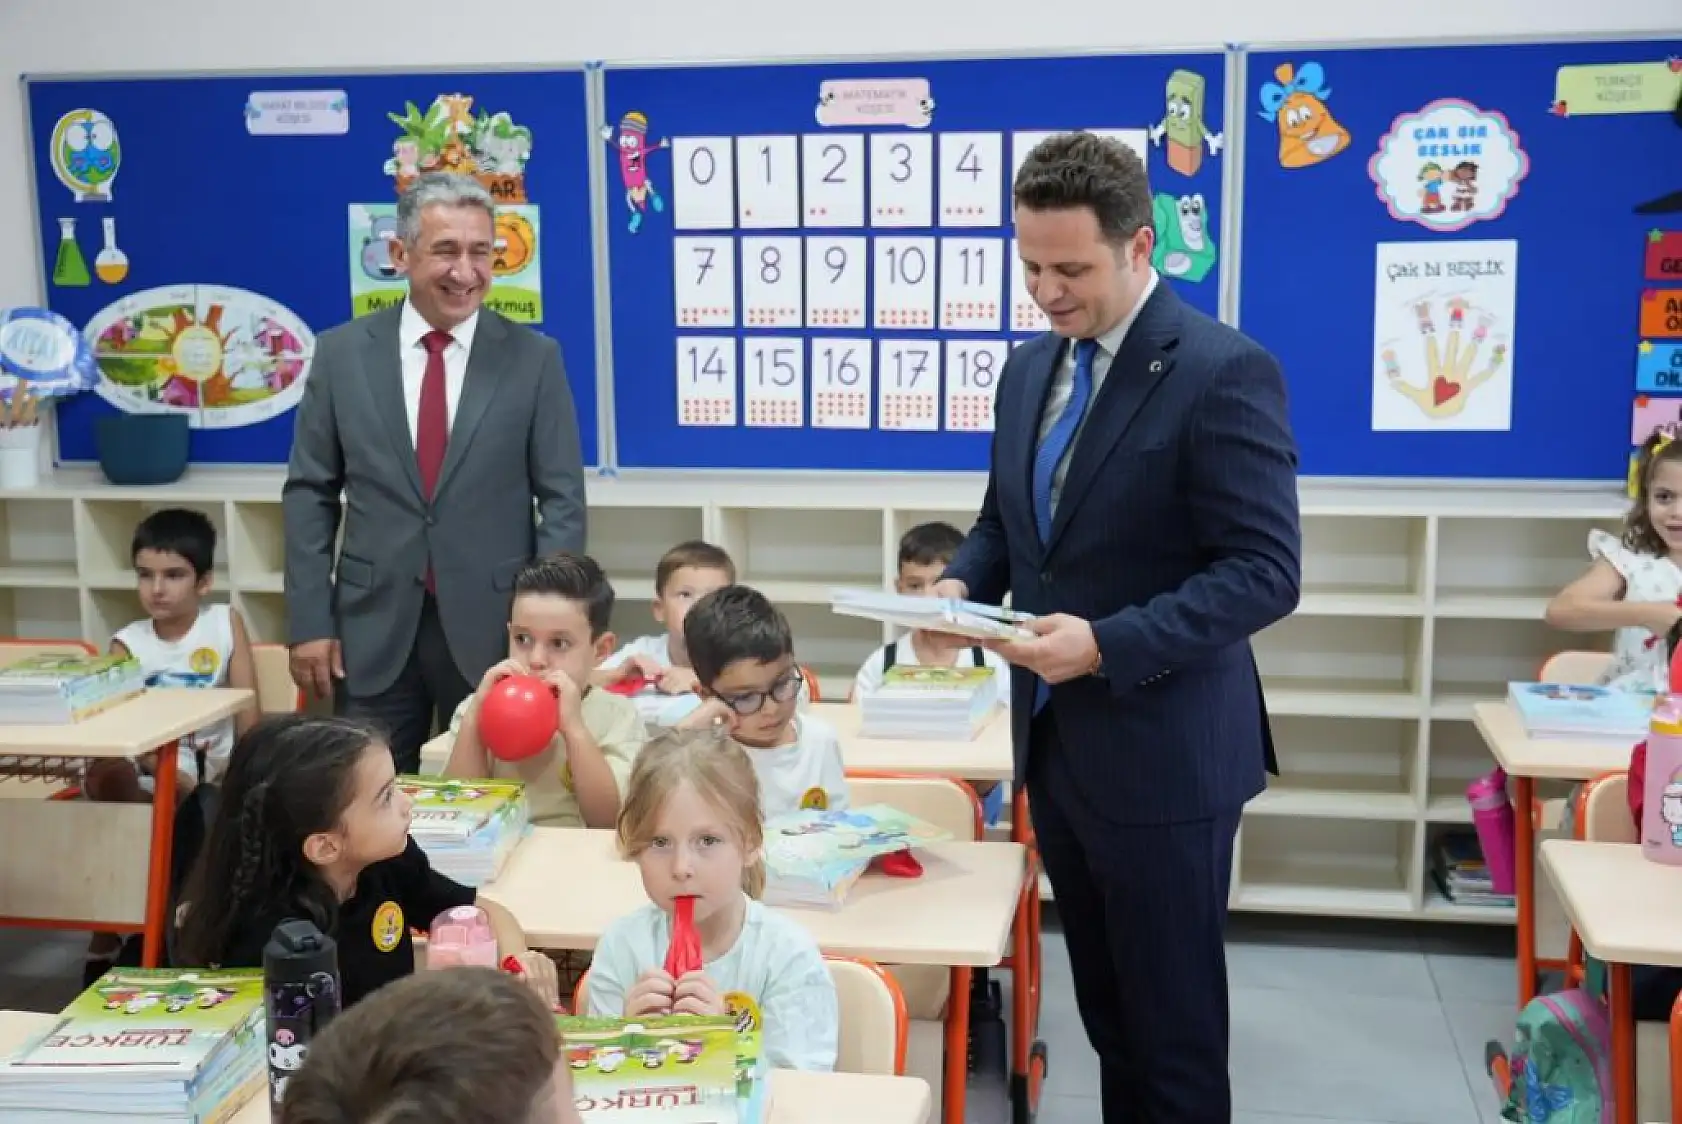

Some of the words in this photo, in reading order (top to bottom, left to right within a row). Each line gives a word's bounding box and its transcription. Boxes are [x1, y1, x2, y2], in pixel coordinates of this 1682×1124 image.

[690, 146, 716, 185] 0
[761, 145, 772, 184] 1
[821, 144, 847, 183] 2
[889, 143, 913, 182] 3
[956, 143, 984, 182] 4
[693, 247, 716, 285] 7
[760, 246, 781, 284] 8
[825, 245, 847, 283] 9
[886, 246, 926, 284] 10
[960, 247, 985, 285] 11
[688, 346, 727, 383] 14
[755, 348, 795, 386] 15
[823, 348, 860, 386] 16
[893, 350, 929, 387] 17
[958, 350, 994, 387] 18
[44, 1032, 190, 1049] TÜRKÇE
[572, 1092, 705, 1111] TÜRKÇ
